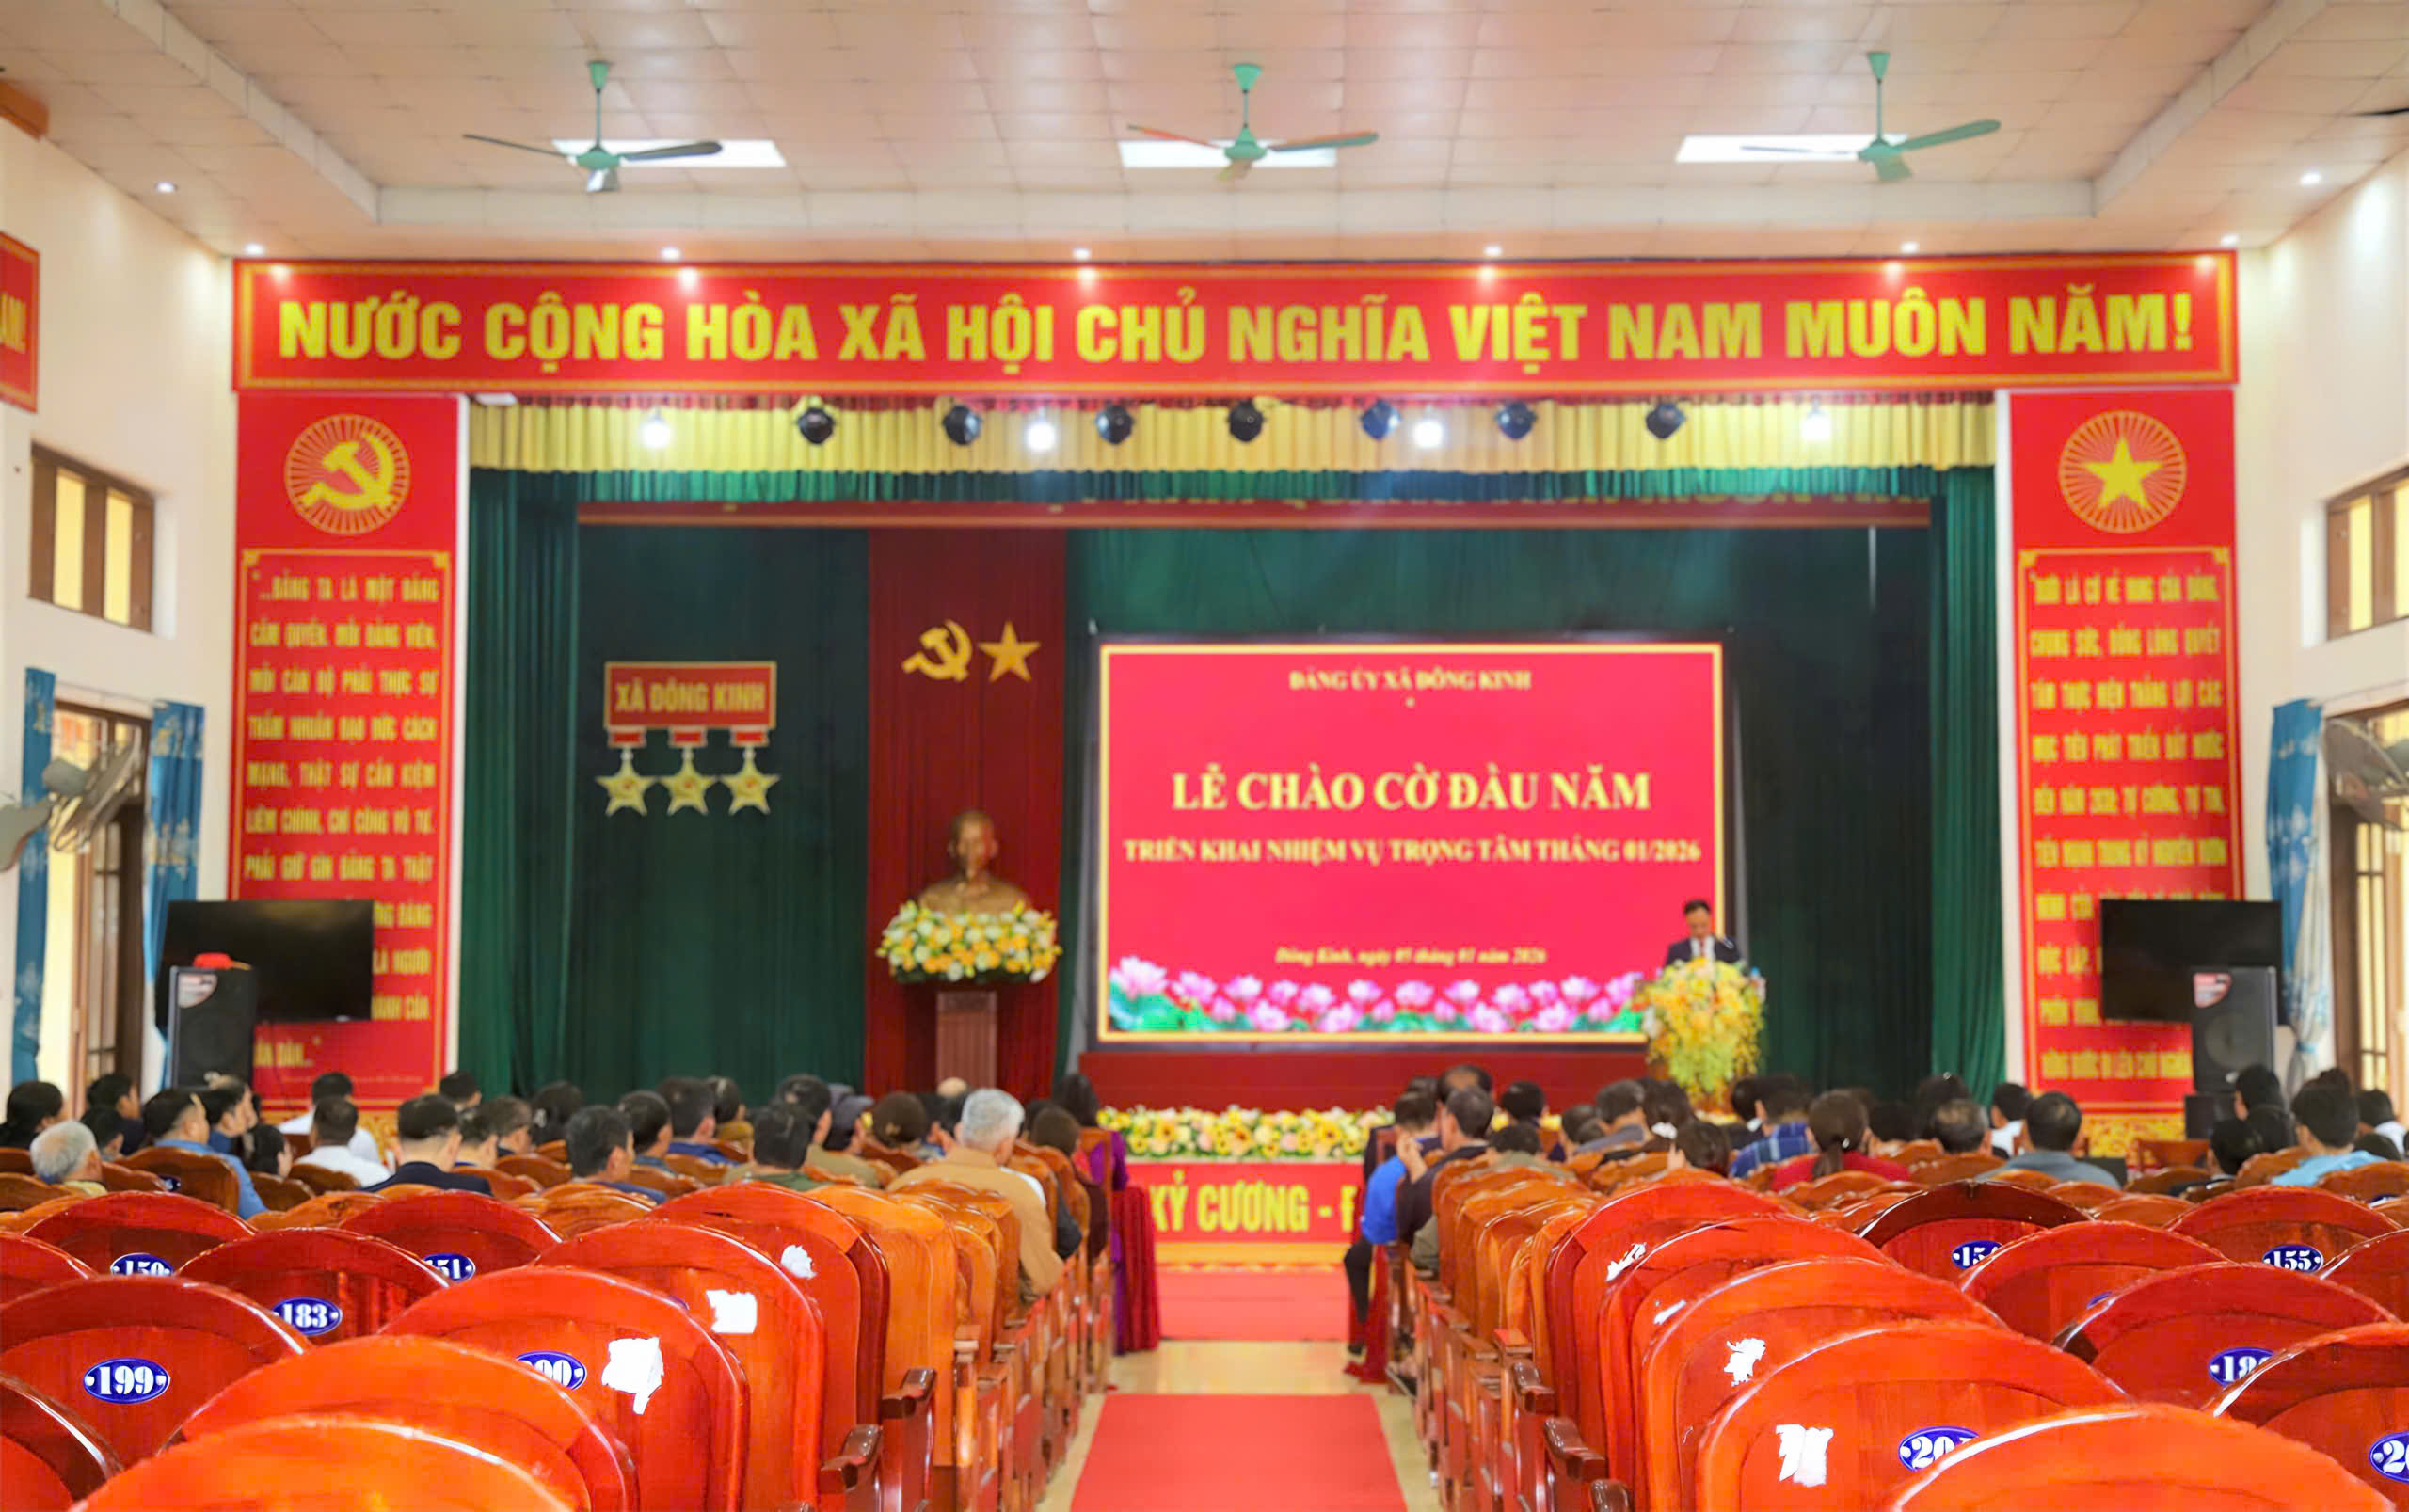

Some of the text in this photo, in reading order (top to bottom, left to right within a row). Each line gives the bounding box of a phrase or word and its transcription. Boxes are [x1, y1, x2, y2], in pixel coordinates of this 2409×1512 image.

[278, 282, 2193, 374] NƯỚC CỘNG HÒA XÃ HỘI CHỦ NGHĨA VIỆT NAM MUÔN NĂM!
[616, 676, 646, 712] XÃ
[712, 682, 766, 712] KINH
[1477, 669, 1532, 691] KINH
[1173, 761, 1651, 811] LỄ CHÀO CỜ ĐẦU NĂM
[1200, 838, 1262, 862] KHAI
[1266, 836, 1347, 867] NHIỆM
[1388, 838, 1474, 867] TRỌNG
[1476, 833, 1532, 862] TÂM
[1534, 833, 1620, 862] THÁNG
[1149, 1169, 1189, 1232] KỶ
[1196, 1179, 1310, 1233] CƯƠNG
[2273, 1250, 2311, 1272] 155
[283, 1303, 327, 1328] 183
[99, 1365, 154, 1395] 199
[1911, 1436, 1972, 1469] 20
